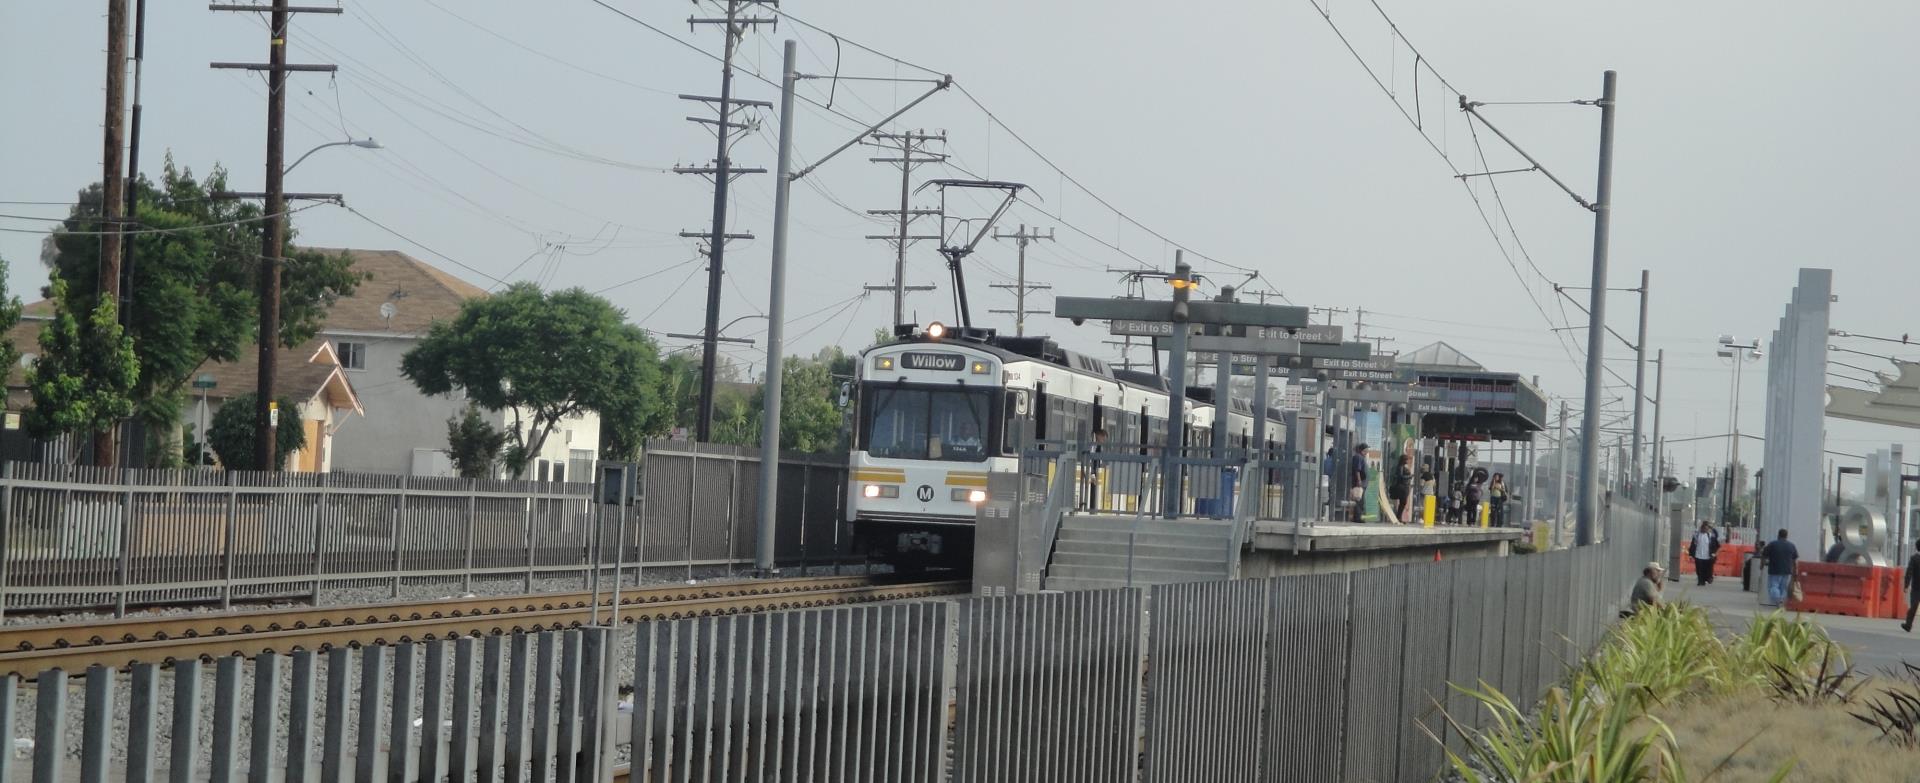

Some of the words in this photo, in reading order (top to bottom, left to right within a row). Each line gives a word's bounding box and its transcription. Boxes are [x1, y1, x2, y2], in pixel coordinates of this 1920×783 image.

[1129, 322, 1146, 333] Exit
[1149, 323, 1159, 333] to
[1280, 331, 1289, 339] to
[1292, 331, 1321, 340] Street
[911, 354, 956, 369] Willow
[1323, 358, 1339, 367] Exit
[1341, 359, 1350, 368] to
[1351, 360, 1377, 369] Street
[1369, 371, 1392, 379] Street
